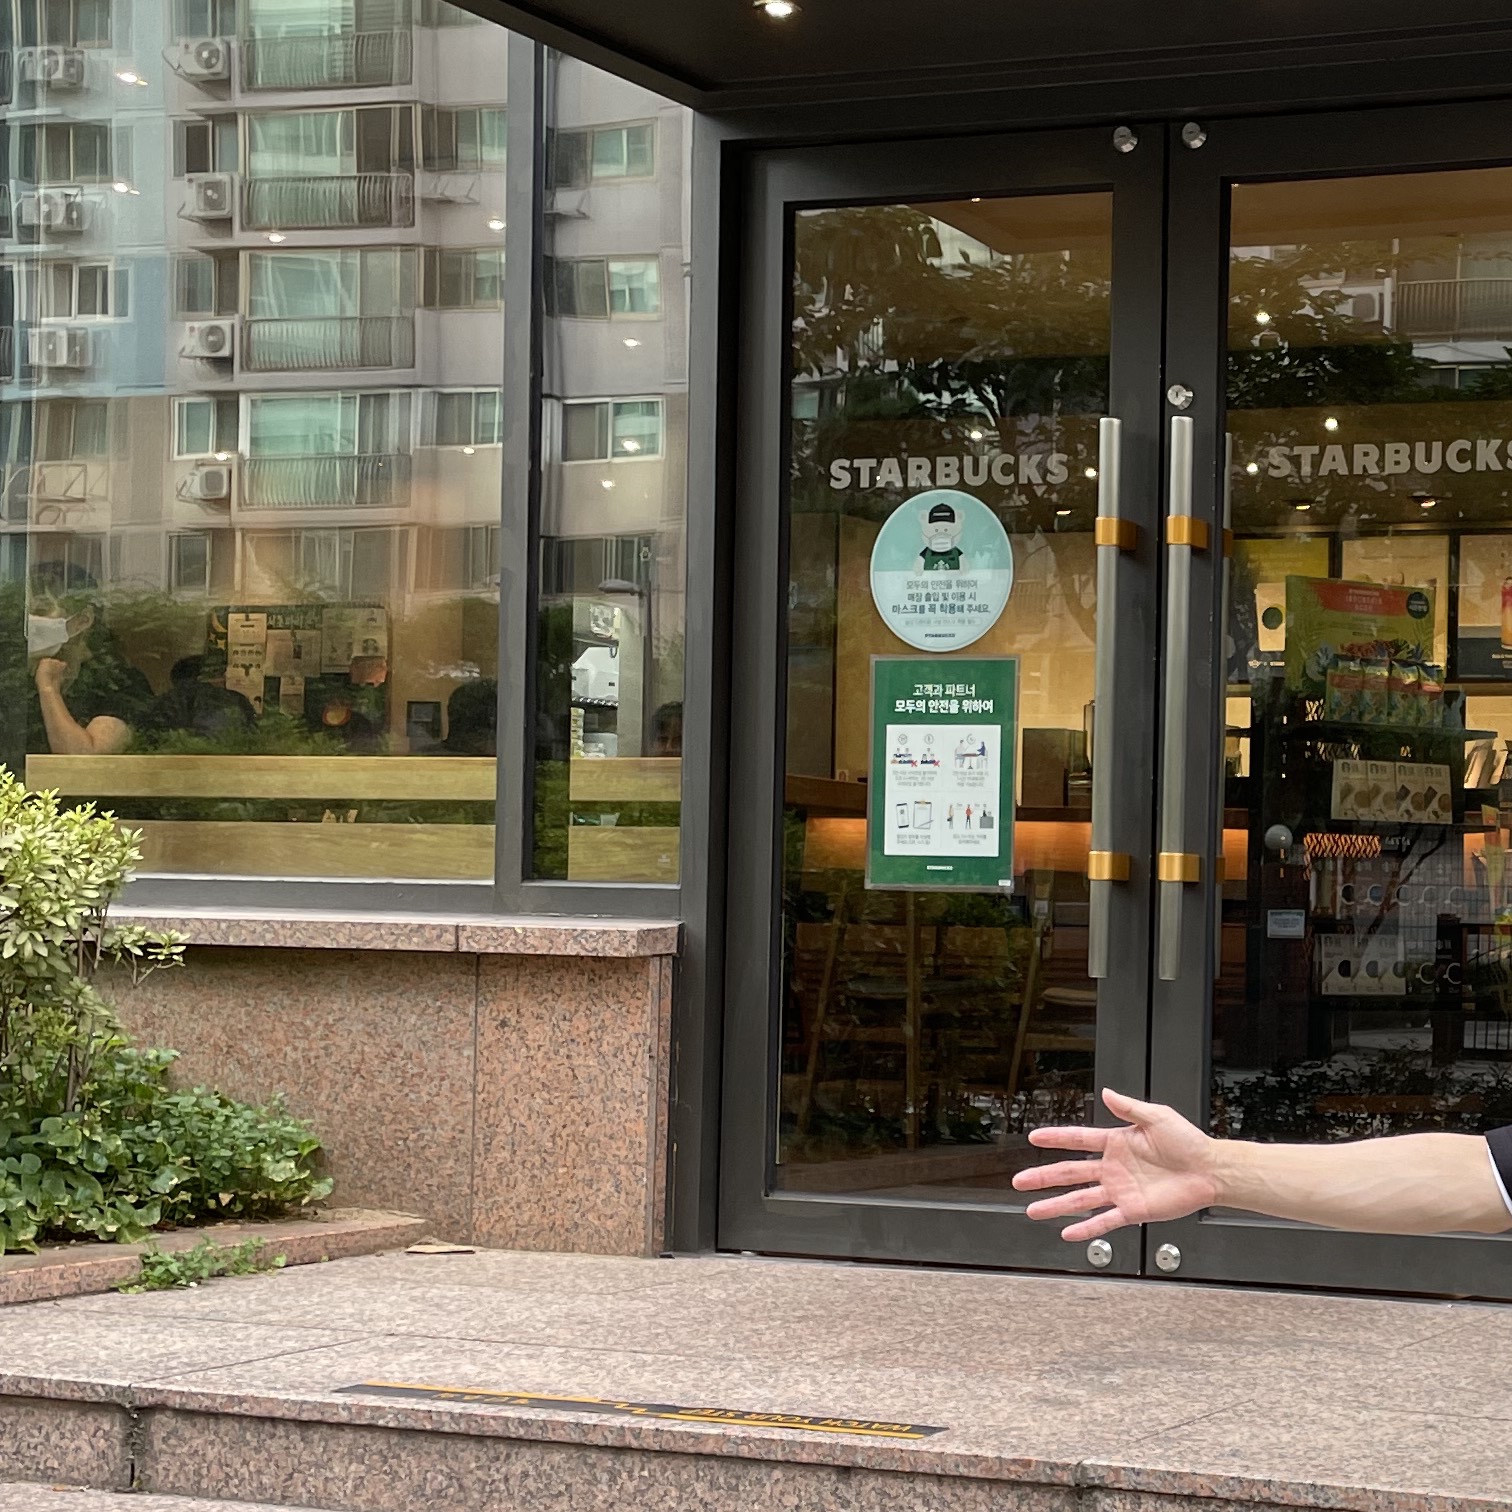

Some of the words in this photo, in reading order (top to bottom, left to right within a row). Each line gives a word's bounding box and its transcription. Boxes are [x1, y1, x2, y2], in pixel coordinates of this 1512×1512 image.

[829, 453, 1069, 490] STARBUCKS
[906, 580, 928, 590] 모두의
[930, 580, 953, 590] 안전을
[907, 592, 922, 603] 매장
[925, 592, 940, 602] 출입
[942, 592, 950, 602] 및
[951, 592, 966, 602] 이용
[969, 592, 977, 602] 시
[892, 604, 925, 615] 마스크를
[928, 603, 937, 614] 꼭
[940, 603, 964, 615] 착용해
[912, 684, 943, 698] 고객과
[944, 684, 976, 698] 파트너
[894, 699, 926, 714] 모두의
[928, 699, 960, 714] 안전을
[962, 699, 994, 714] 위하여
